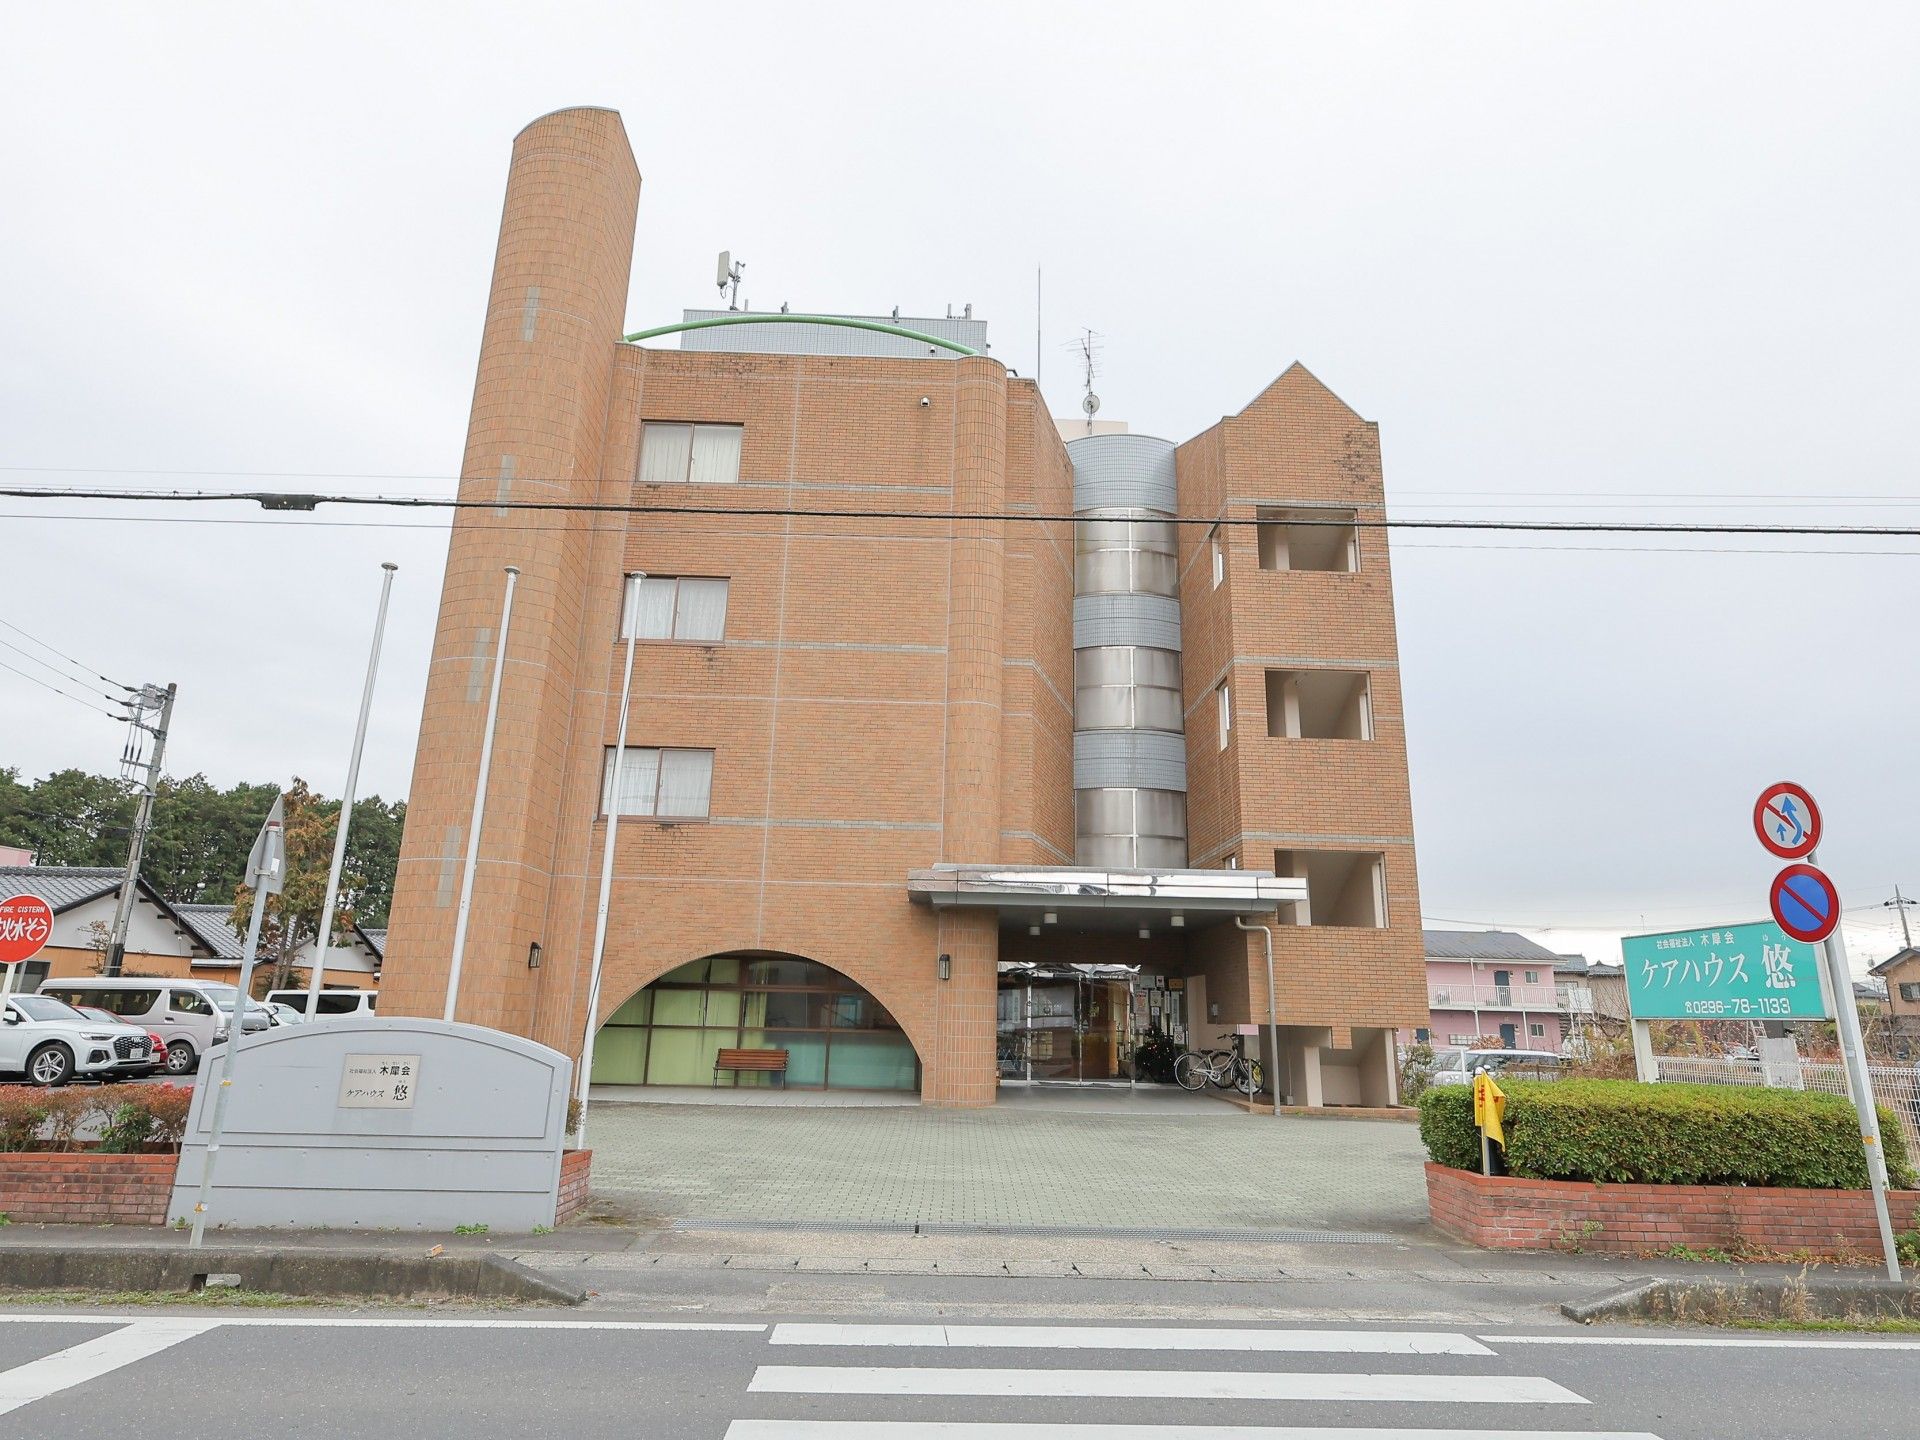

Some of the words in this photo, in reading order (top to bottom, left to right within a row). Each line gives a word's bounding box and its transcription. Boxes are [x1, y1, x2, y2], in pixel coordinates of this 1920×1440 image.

[1656, 936, 1695, 950] 社会福祉法人
[1700, 931, 1735, 946] 木犀会
[1641, 952, 1748, 990] ケアハウス
[1762, 943, 1796, 989] 悠
[1694, 997, 1791, 1014] 0296-78-1133
[346, 1089, 385, 1098] ケアハウス
[392, 1084, 408, 1101] 悠
